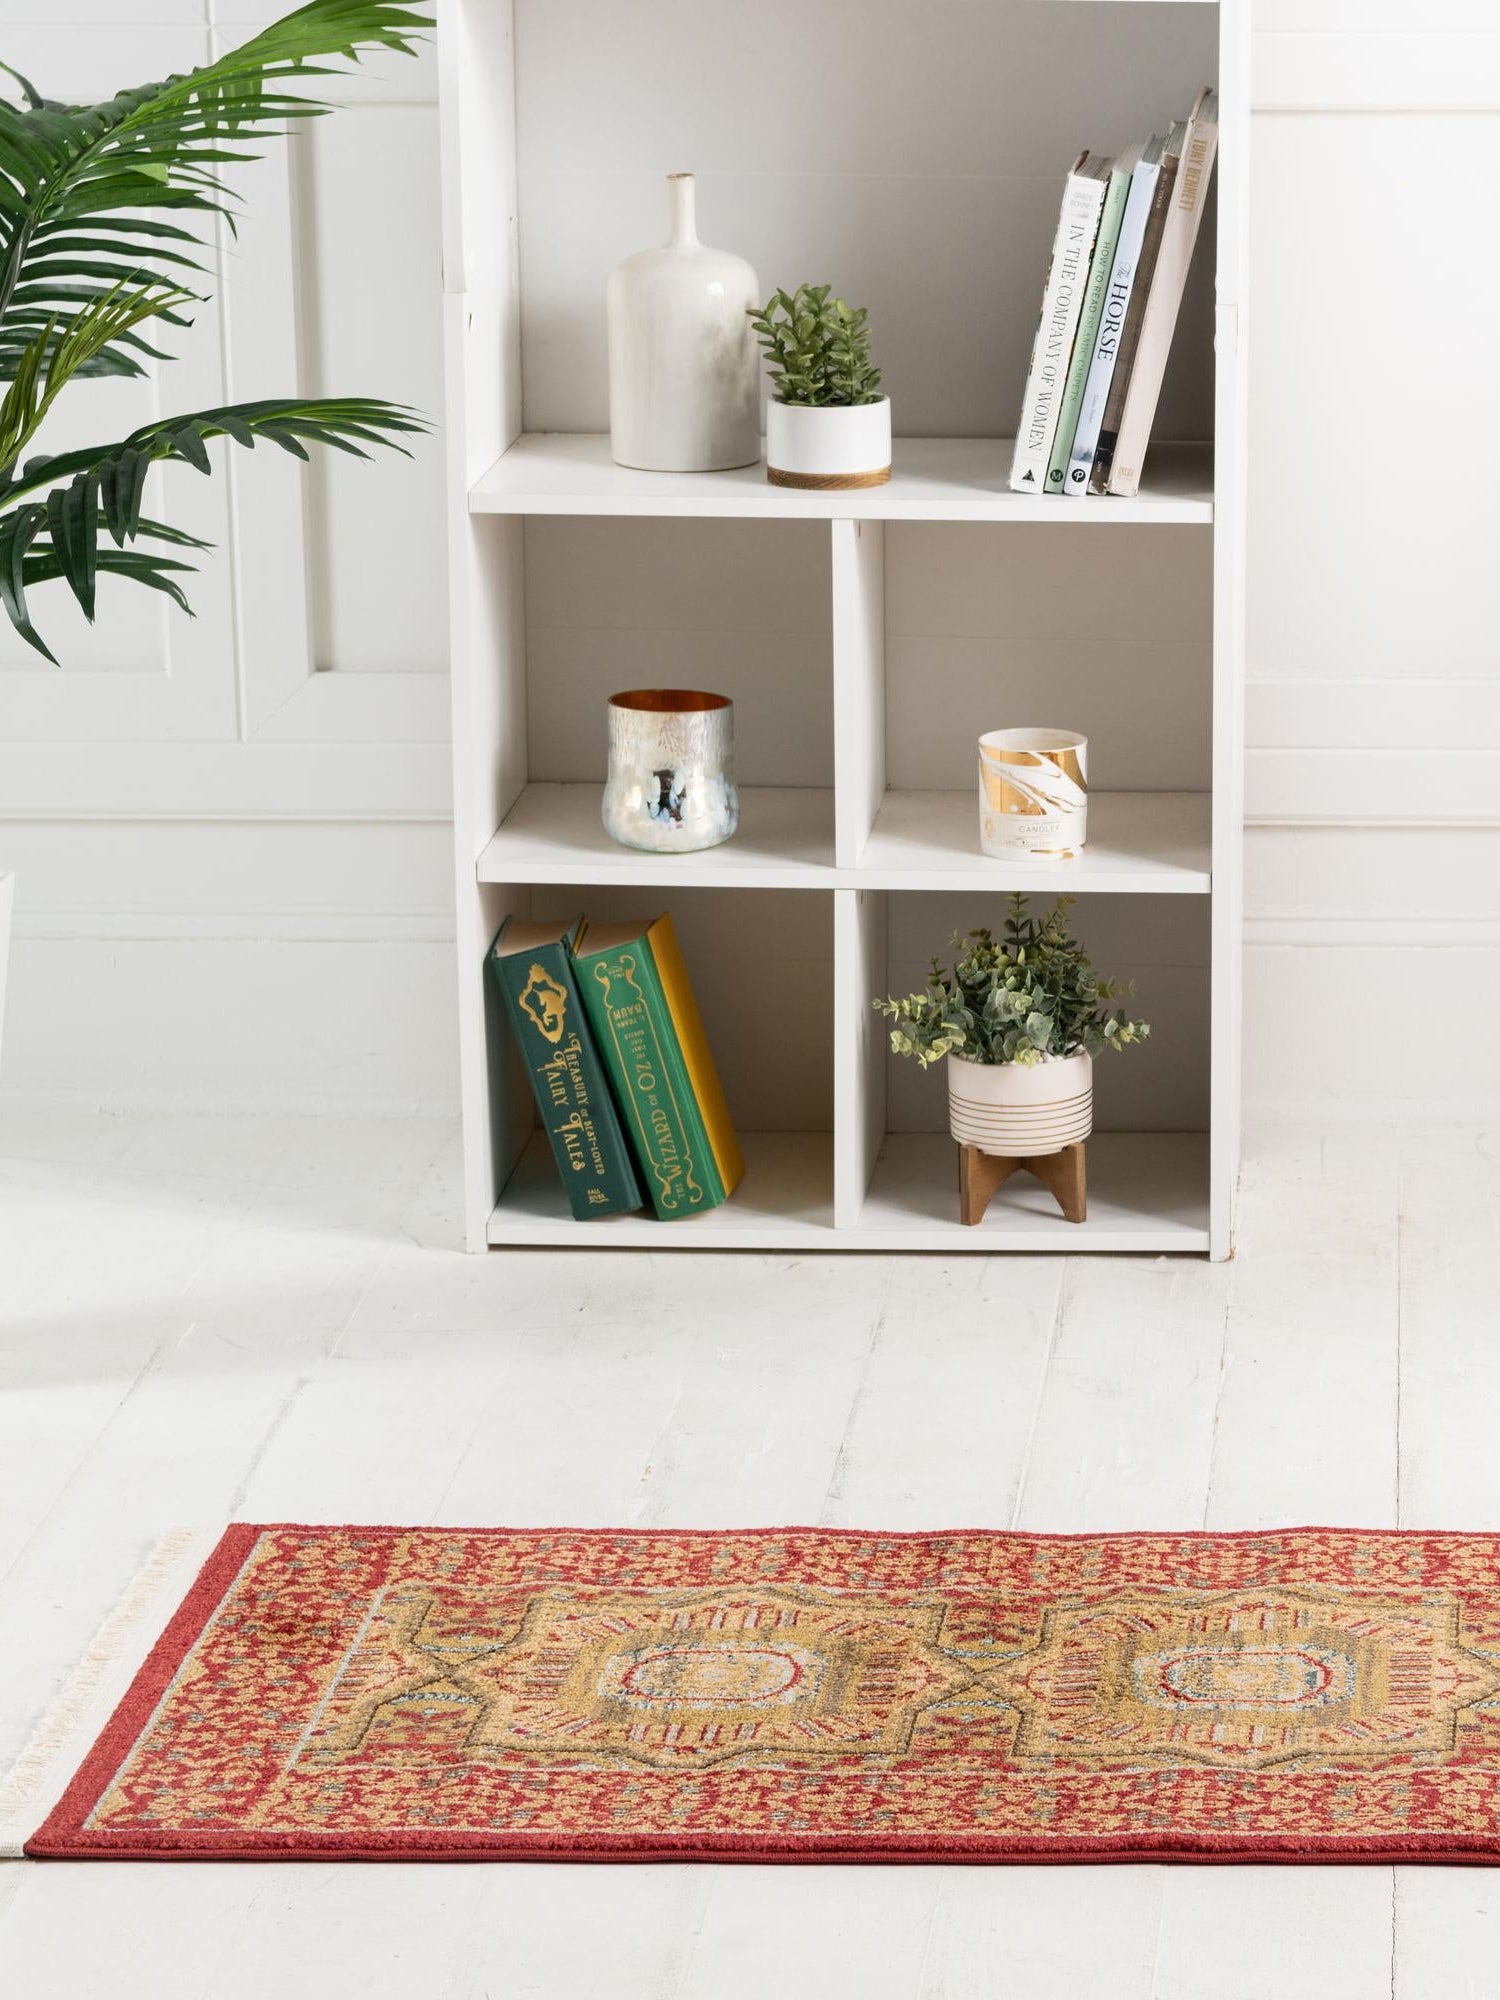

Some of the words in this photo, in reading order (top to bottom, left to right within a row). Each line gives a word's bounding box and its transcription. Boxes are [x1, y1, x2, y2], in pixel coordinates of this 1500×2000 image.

[1189, 139, 1207, 167] TONY
[1178, 167, 1203, 213] BENNETT
[1069, 225, 1085, 242] IN
[1061, 248, 1081, 281] THE
[1098, 241, 1111, 267] HOW
[1095, 266, 1106, 284] TO
[1117, 261, 1132, 280] The
[1089, 286, 1102, 314] READ
[1045, 285, 1073, 363] COMPANY
[1078, 314, 1096, 356] ISLAMIC
[1097, 282, 1128, 361] HORSE
[1042, 365, 1057, 388] OF
[1071, 359, 1086, 402] CARPETS
[1028, 392, 1053, 452] WOMEN
[612, 1003, 643, 1020] BAUM
[564, 1038, 590, 1105] TREASURY
[635, 1061, 656, 1092] OZ
[536, 1050, 569, 1107] FAIRY
[553, 1111, 587, 1171] TALES
[580, 1108, 589, 1118] OF
[648, 1094, 658, 1106] OF
[583, 1119, 605, 1176] BEST-LOVED
[651, 1108, 682, 1181] WIZARD
